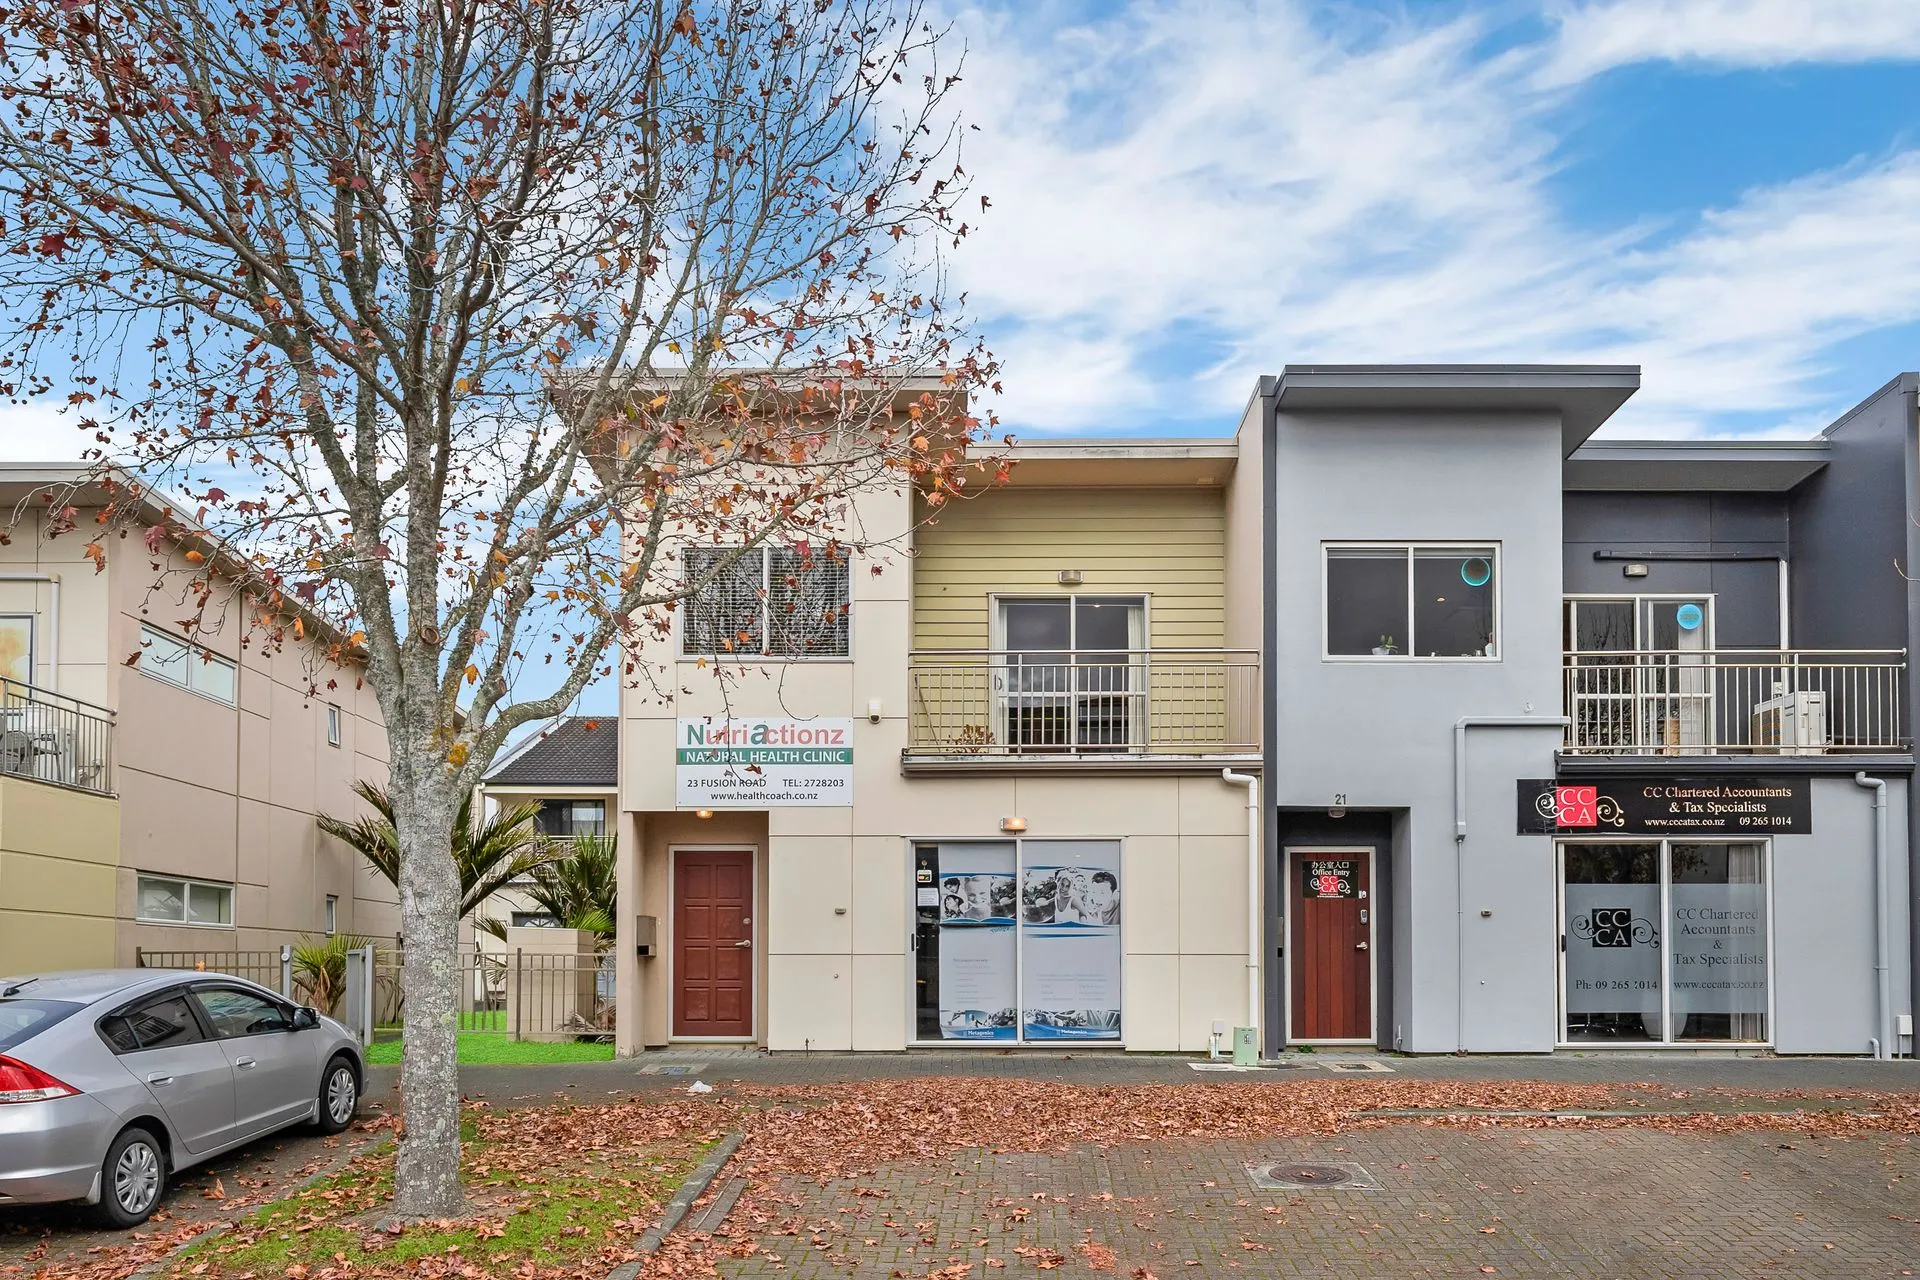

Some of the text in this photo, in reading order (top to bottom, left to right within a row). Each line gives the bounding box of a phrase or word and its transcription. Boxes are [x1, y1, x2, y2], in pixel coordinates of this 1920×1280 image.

[686, 751, 845, 763] NATURAL HEALTH CLINIC
[701, 779, 737, 787] FUSION
[739, 779, 767, 787] ROAD
[783, 779, 802, 787] TEL:
[804, 779, 845, 787] 2728203
[711, 792, 818, 800] www.healthcoach.co.nz
[1560, 789, 1592, 805] CC
[1643, 787, 1792, 798] CC Chartered Accountants
[1335, 794, 1347, 804] 21
[1669, 801, 1767, 815] & Tax Specialists
[1560, 807, 1594, 824] CA
[1739, 817, 1751, 825] 09
[1752, 817, 1769, 825] 265
[1771, 817, 1792, 825] 1014
[1333, 869, 1350, 877] Entry
[1321, 876, 1338, 885] CC
[1321, 885, 1336, 893] CA
[1596, 911, 1629, 927] CC
[1676, 908, 1759, 920] CC Chartered
[1681, 923, 1756, 935] Accountants
[1595, 930, 1629, 946] CA
[1713, 940, 1723, 950] &
[1673, 953, 1764, 967] Tax Specialists
[1576, 980, 1592, 990] Ph:
[1595, 981, 1608, 990] 09
[1611, 981, 1630, 990] 265
[1673, 981, 1765, 989] www.cccatax.co.nz
